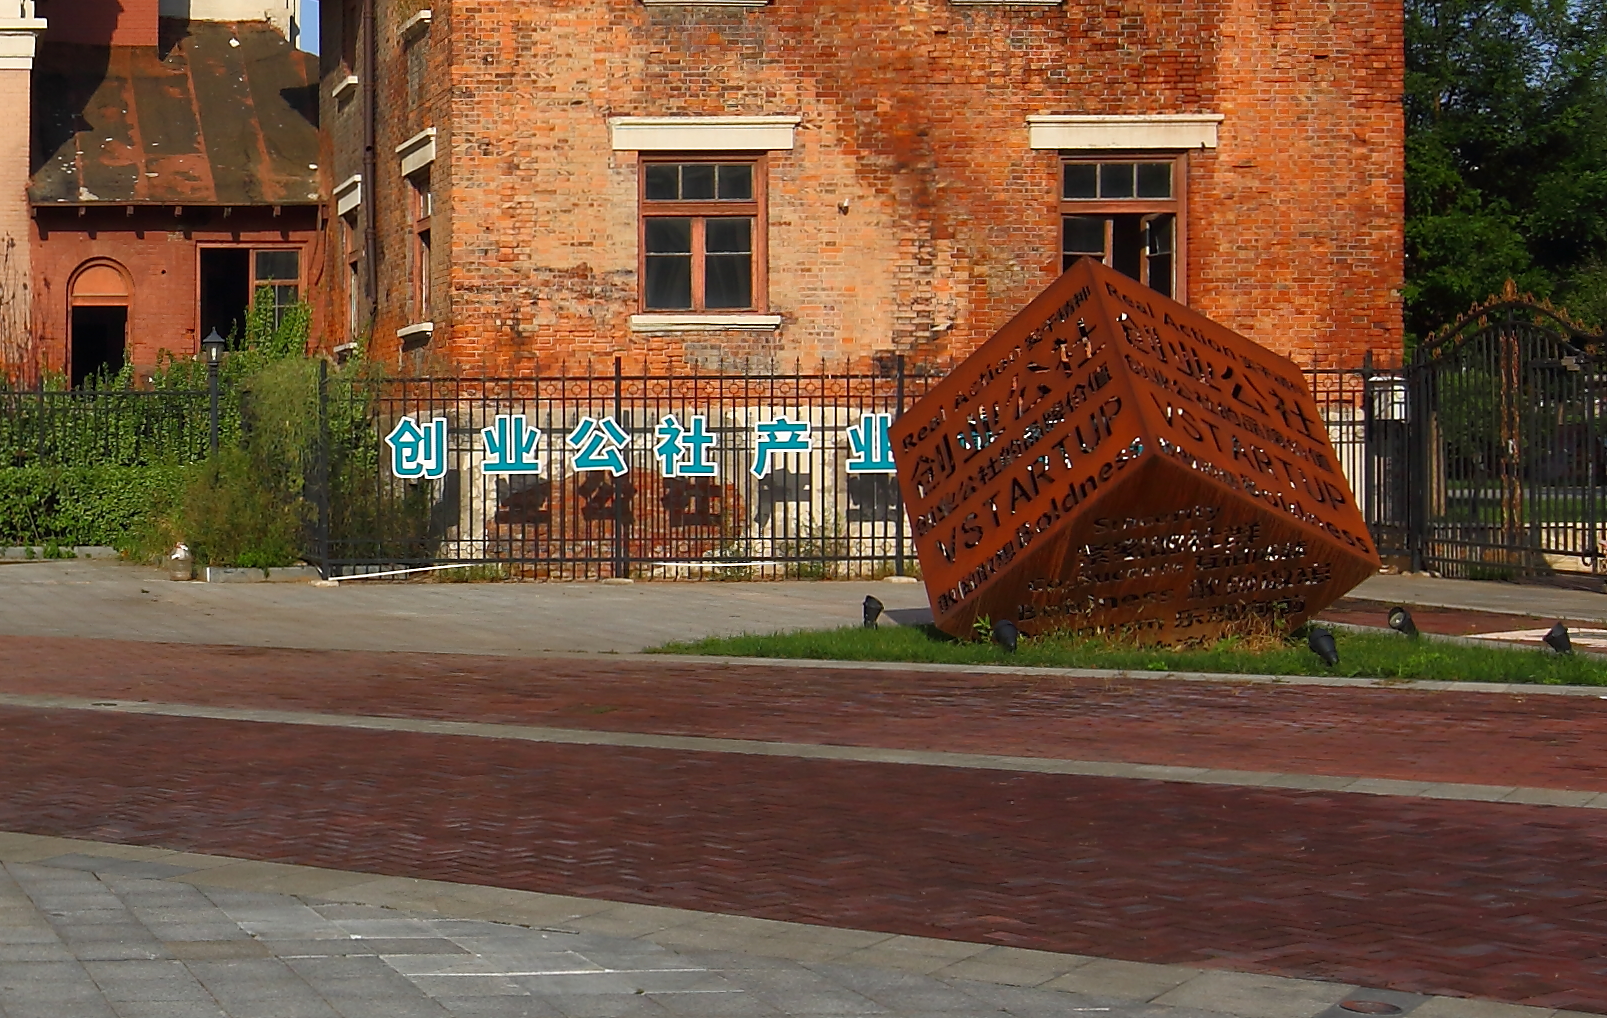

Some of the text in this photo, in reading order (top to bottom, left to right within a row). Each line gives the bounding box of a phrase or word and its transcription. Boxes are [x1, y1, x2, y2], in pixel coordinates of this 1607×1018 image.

[1105, 281, 1155, 318] Real
[1163, 313, 1236, 361] Action
[1115, 312, 1325, 446] 创业公社
[902, 404, 946, 452] Real
[954, 345, 1022, 412] Action
[911, 317, 1106, 499] 创业公社
[915, 361, 1113, 537] 创业公社的品牌价值
[1150, 392, 1346, 511] VSTARTUP
[936, 395, 1123, 564] VSTARTUP
[1016, 436, 1144, 549] Boldness
[1240, 473, 1370, 554] Boldness
